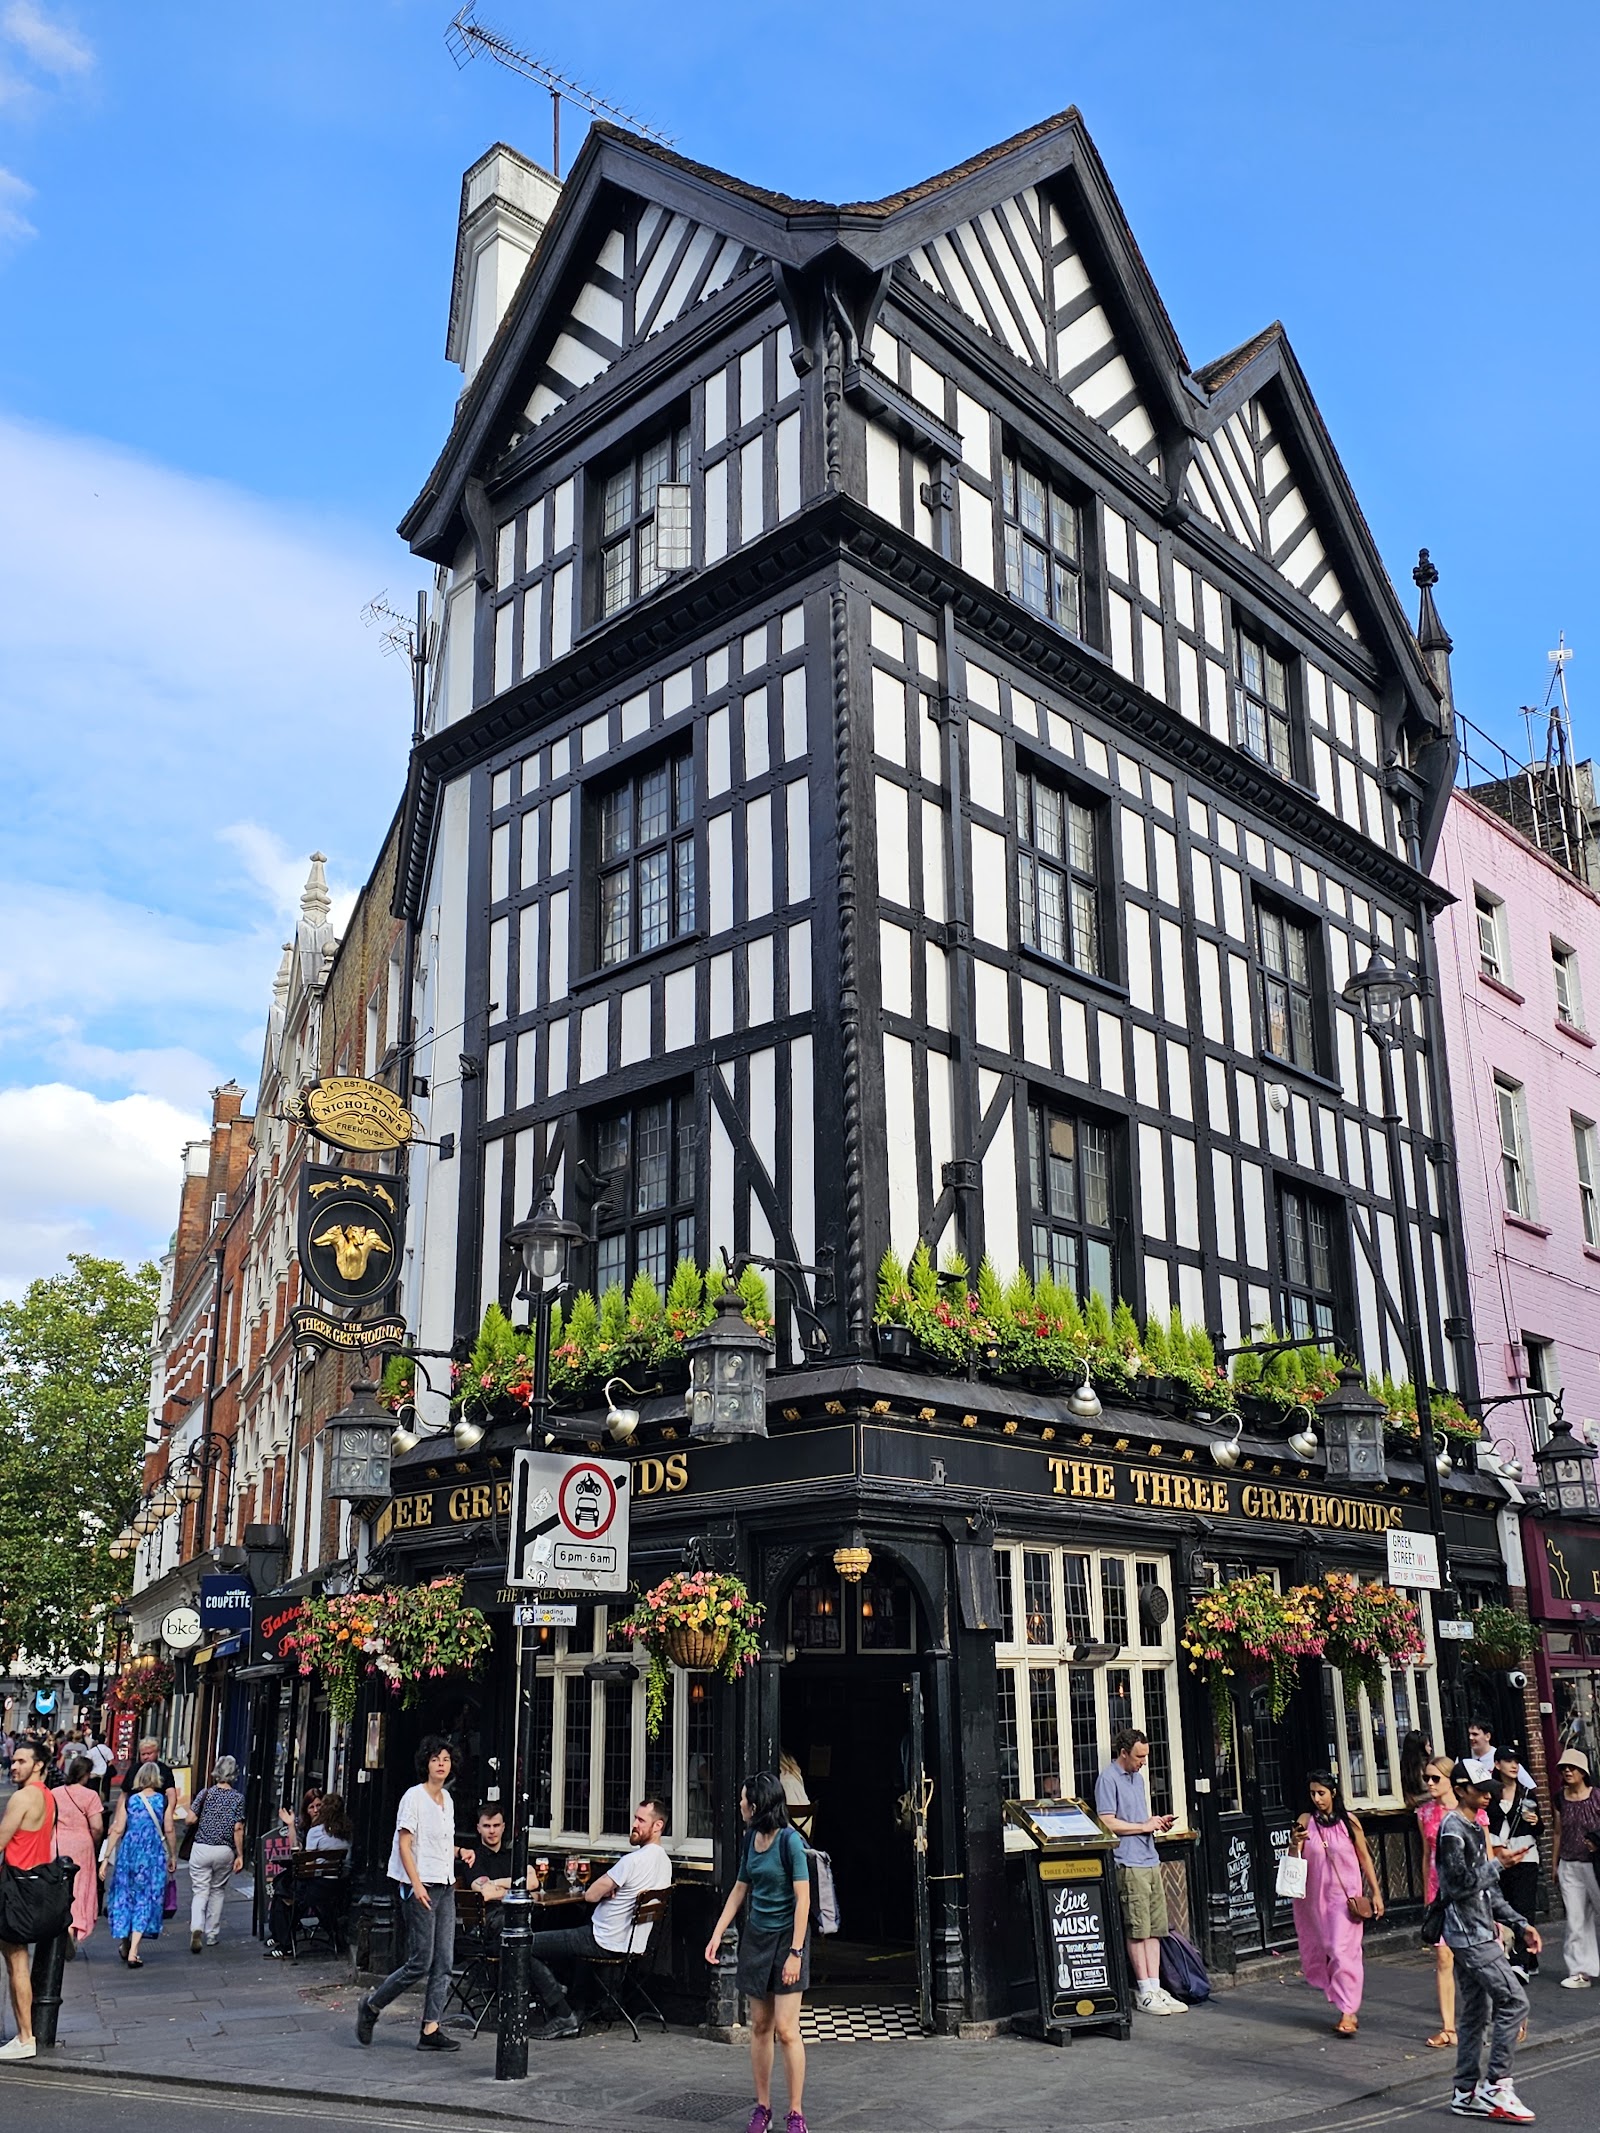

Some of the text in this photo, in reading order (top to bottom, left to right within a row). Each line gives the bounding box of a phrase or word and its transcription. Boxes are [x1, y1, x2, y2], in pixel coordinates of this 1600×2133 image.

[365, 1083, 383, 1096] 1873
[322, 1101, 404, 1131] NICHOLSON'S
[337, 1122, 385, 1139] FREEHOUSE
[298, 1317, 404, 1346] THREE GREYHOUNDS
[342, 1323, 362, 1332] THE
[1048, 1457, 1403, 1532] THE THREE GREYHOUNDS
[1392, 1535, 1413, 1549] GREEK
[1393, 1551, 1427, 1566] STREET W1
[205, 1595, 251, 1609] COUPETTE
[167, 1618, 198, 1635] bkc
[1270, 1829, 1291, 1847] CRAFT
[1229, 1836, 1247, 1860] Live
[1062, 1866, 1100, 1874] GREYHOUNDS
[1229, 1855, 1250, 1876] MUSIC
[1053, 1888, 1089, 1914] Live
[1053, 1915, 1100, 1937] MUSIC
